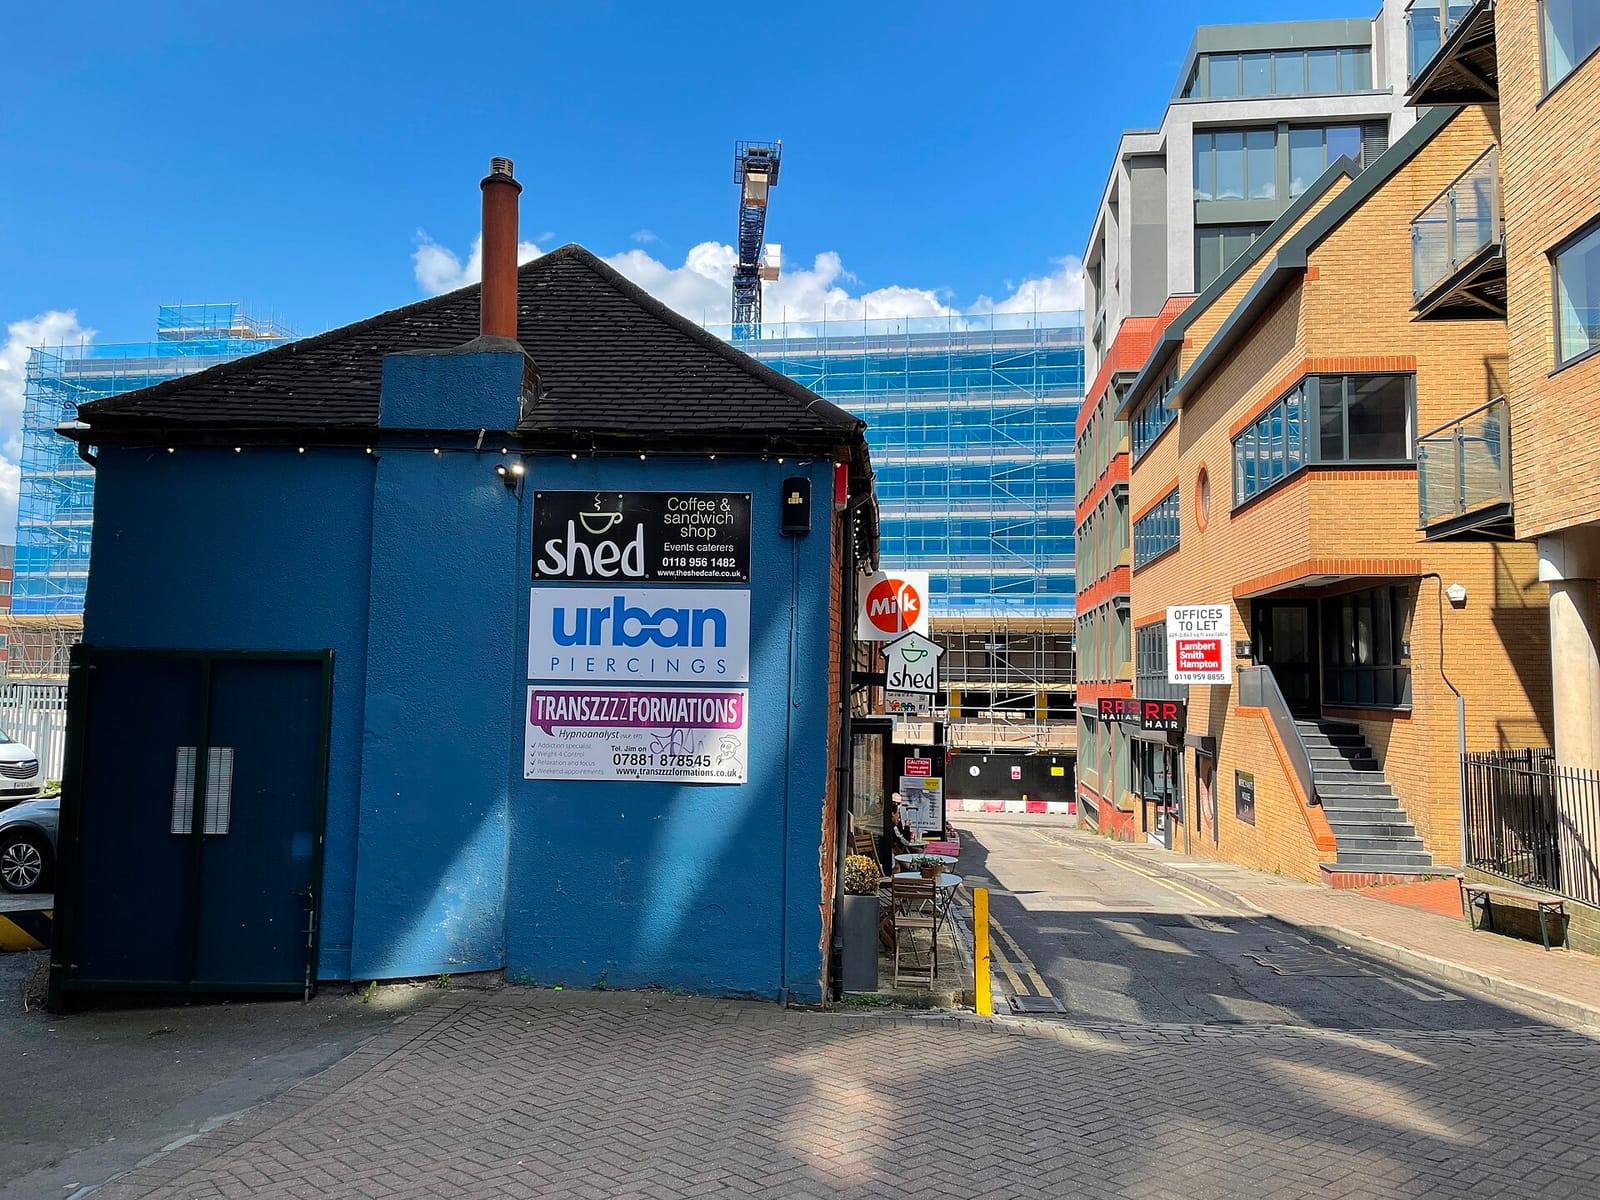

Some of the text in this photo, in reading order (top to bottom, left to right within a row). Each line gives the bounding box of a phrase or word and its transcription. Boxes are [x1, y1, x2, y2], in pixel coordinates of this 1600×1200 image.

[668, 497, 731, 511] Coffee &
[664, 511, 734, 524] sandwich
[680, 524, 716, 540] shop
[537, 519, 644, 577] shed
[664, 542, 734, 552] Events caterers
[662, 557, 735, 567] 0118 956 1482
[657, 569, 741, 577] www.theshedcafe.co.uk
[1174, 609, 1223, 619] OFFICES
[552, 596, 726, 648] urban
[1179, 621, 1218, 631] TO LET
[1179, 642, 1216, 650] Lambert
[1180, 651, 1204, 659] Smith
[551, 657, 726, 674] PIERCINGS
[1180, 660, 1218, 669] Hampton
[889, 664, 934, 689] shed
[535, 695, 738, 724] TRANSZZZZFORMATIONS
[1145, 703, 1177, 720] RR
[559, 729, 619, 740] Hypnoanalyst
[613, 754, 711, 767] 07881 878545
[616, 767, 737, 777] www.transzzzzformations.co.uk
